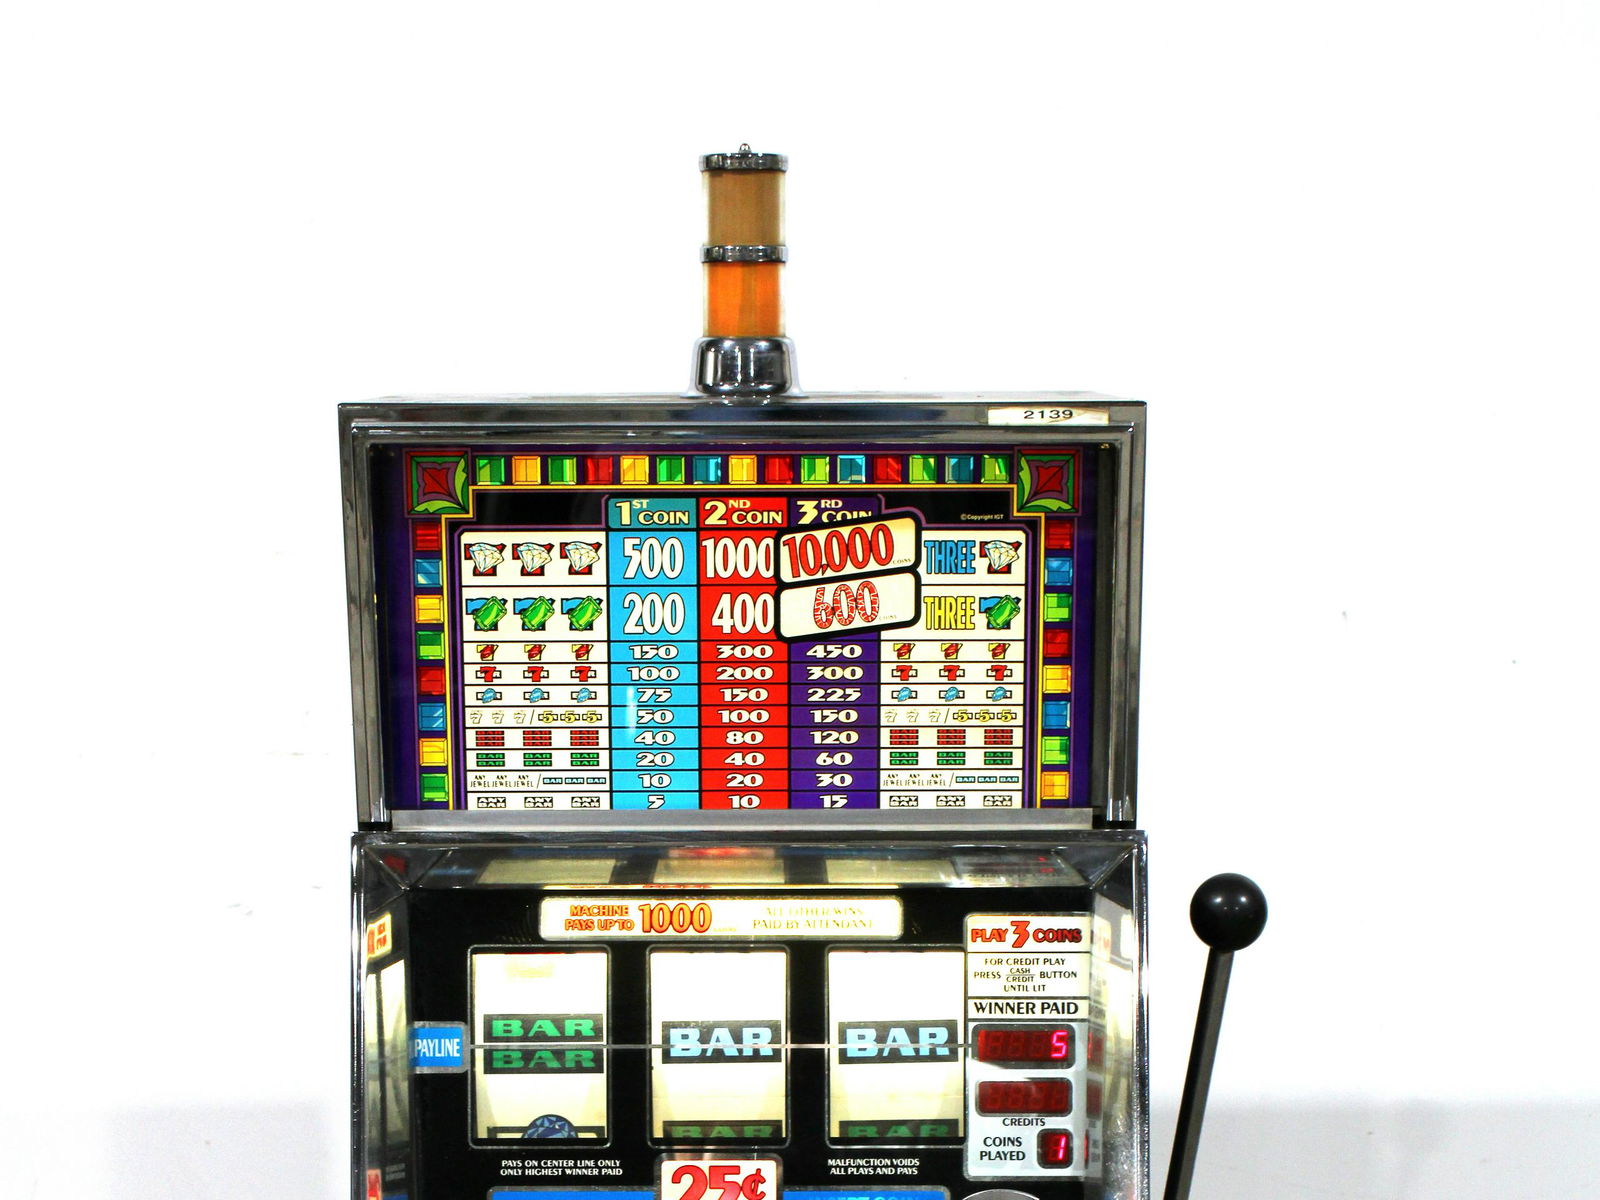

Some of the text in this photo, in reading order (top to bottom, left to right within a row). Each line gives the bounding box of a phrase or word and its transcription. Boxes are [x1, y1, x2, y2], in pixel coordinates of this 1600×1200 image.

[1023, 409, 1074, 420] 2139
[638, 511, 689, 525] COIN
[731, 510, 783, 525] COIN
[623, 537, 684, 579] 500
[701, 537, 775, 579] 1000
[783, 523, 894, 579] 10,000
[924, 539, 976, 574] THREE
[813, 580, 880, 630] 600
[923, 595, 975, 630] THREE
[623, 592, 685, 635] 200
[711, 592, 775, 635] 400
[629, 644, 679, 660] 150
[716, 644, 774, 660] 300
[806, 644, 863, 660] 450
[627, 665, 680, 681] 100
[716, 665, 774, 681] 200
[806, 665, 864, 681] 300
[637, 687, 672, 703] 75
[719, 687, 769, 703] 150
[807, 687, 862, 703] 225
[636, 709, 674, 724] 50
[718, 709, 770, 724] 100
[810, 709, 859, 724] 150
[635, 730, 676, 745] 40
[725, 730, 764, 745] 80
[810, 730, 859, 745] 120
[636, 752, 675, 767] 20
[724, 752, 765, 767] 40
[815, 752, 854, 767] 60
[638, 773, 672, 788] 10
[726, 773, 764, 788] 20
[815, 773, 854, 788] 30
[648, 795, 665, 809] 5
[728, 795, 761, 809] 10
[819, 795, 848, 809] 15
[569, 904, 629, 917] MACHINE
[564, 919, 635, 932] PAYS UP TO
[638, 903, 713, 934] 1000
[753, 919, 873, 930] PAID BY ATTENDANT
[971, 920, 1082, 949] PLAY 3 COINS
[984, 957, 1066, 966] FOR CREDIT PLAY
[973, 970, 1077, 980] PRESS BUTTON
[1010, 967, 1031, 975] CASH
[1006, 975, 1035, 983] CREDIT
[1003, 984, 1046, 992] UNTIL LIT
[973, 1002, 1079, 1015] WINNER PAID
[492, 1019, 595, 1037] BAR
[414, 1038, 460, 1057] PAYLINE
[669, 1027, 774, 1057] BAR
[845, 1027, 950, 1057] BAR
[1051, 1030, 1069, 1060] 5
[492, 1050, 595, 1068] BAR
[1002, 1117, 1046, 1127] CREDITS
[983, 1136, 1023, 1147] COINS
[1056, 1135, 1067, 1161] 1
[501, 1159, 621, 1168] PAYS ON CENTER LINE ONLY
[827, 1158, 920, 1167] MALFUNCTION VOIDS
[980, 1150, 1026, 1162] PLAYED
[500, 1167, 624, 1176] ONLY HIGHEST WINNER PAID
[830, 1167, 918, 1175] ALL PLAYS AND PAYS
